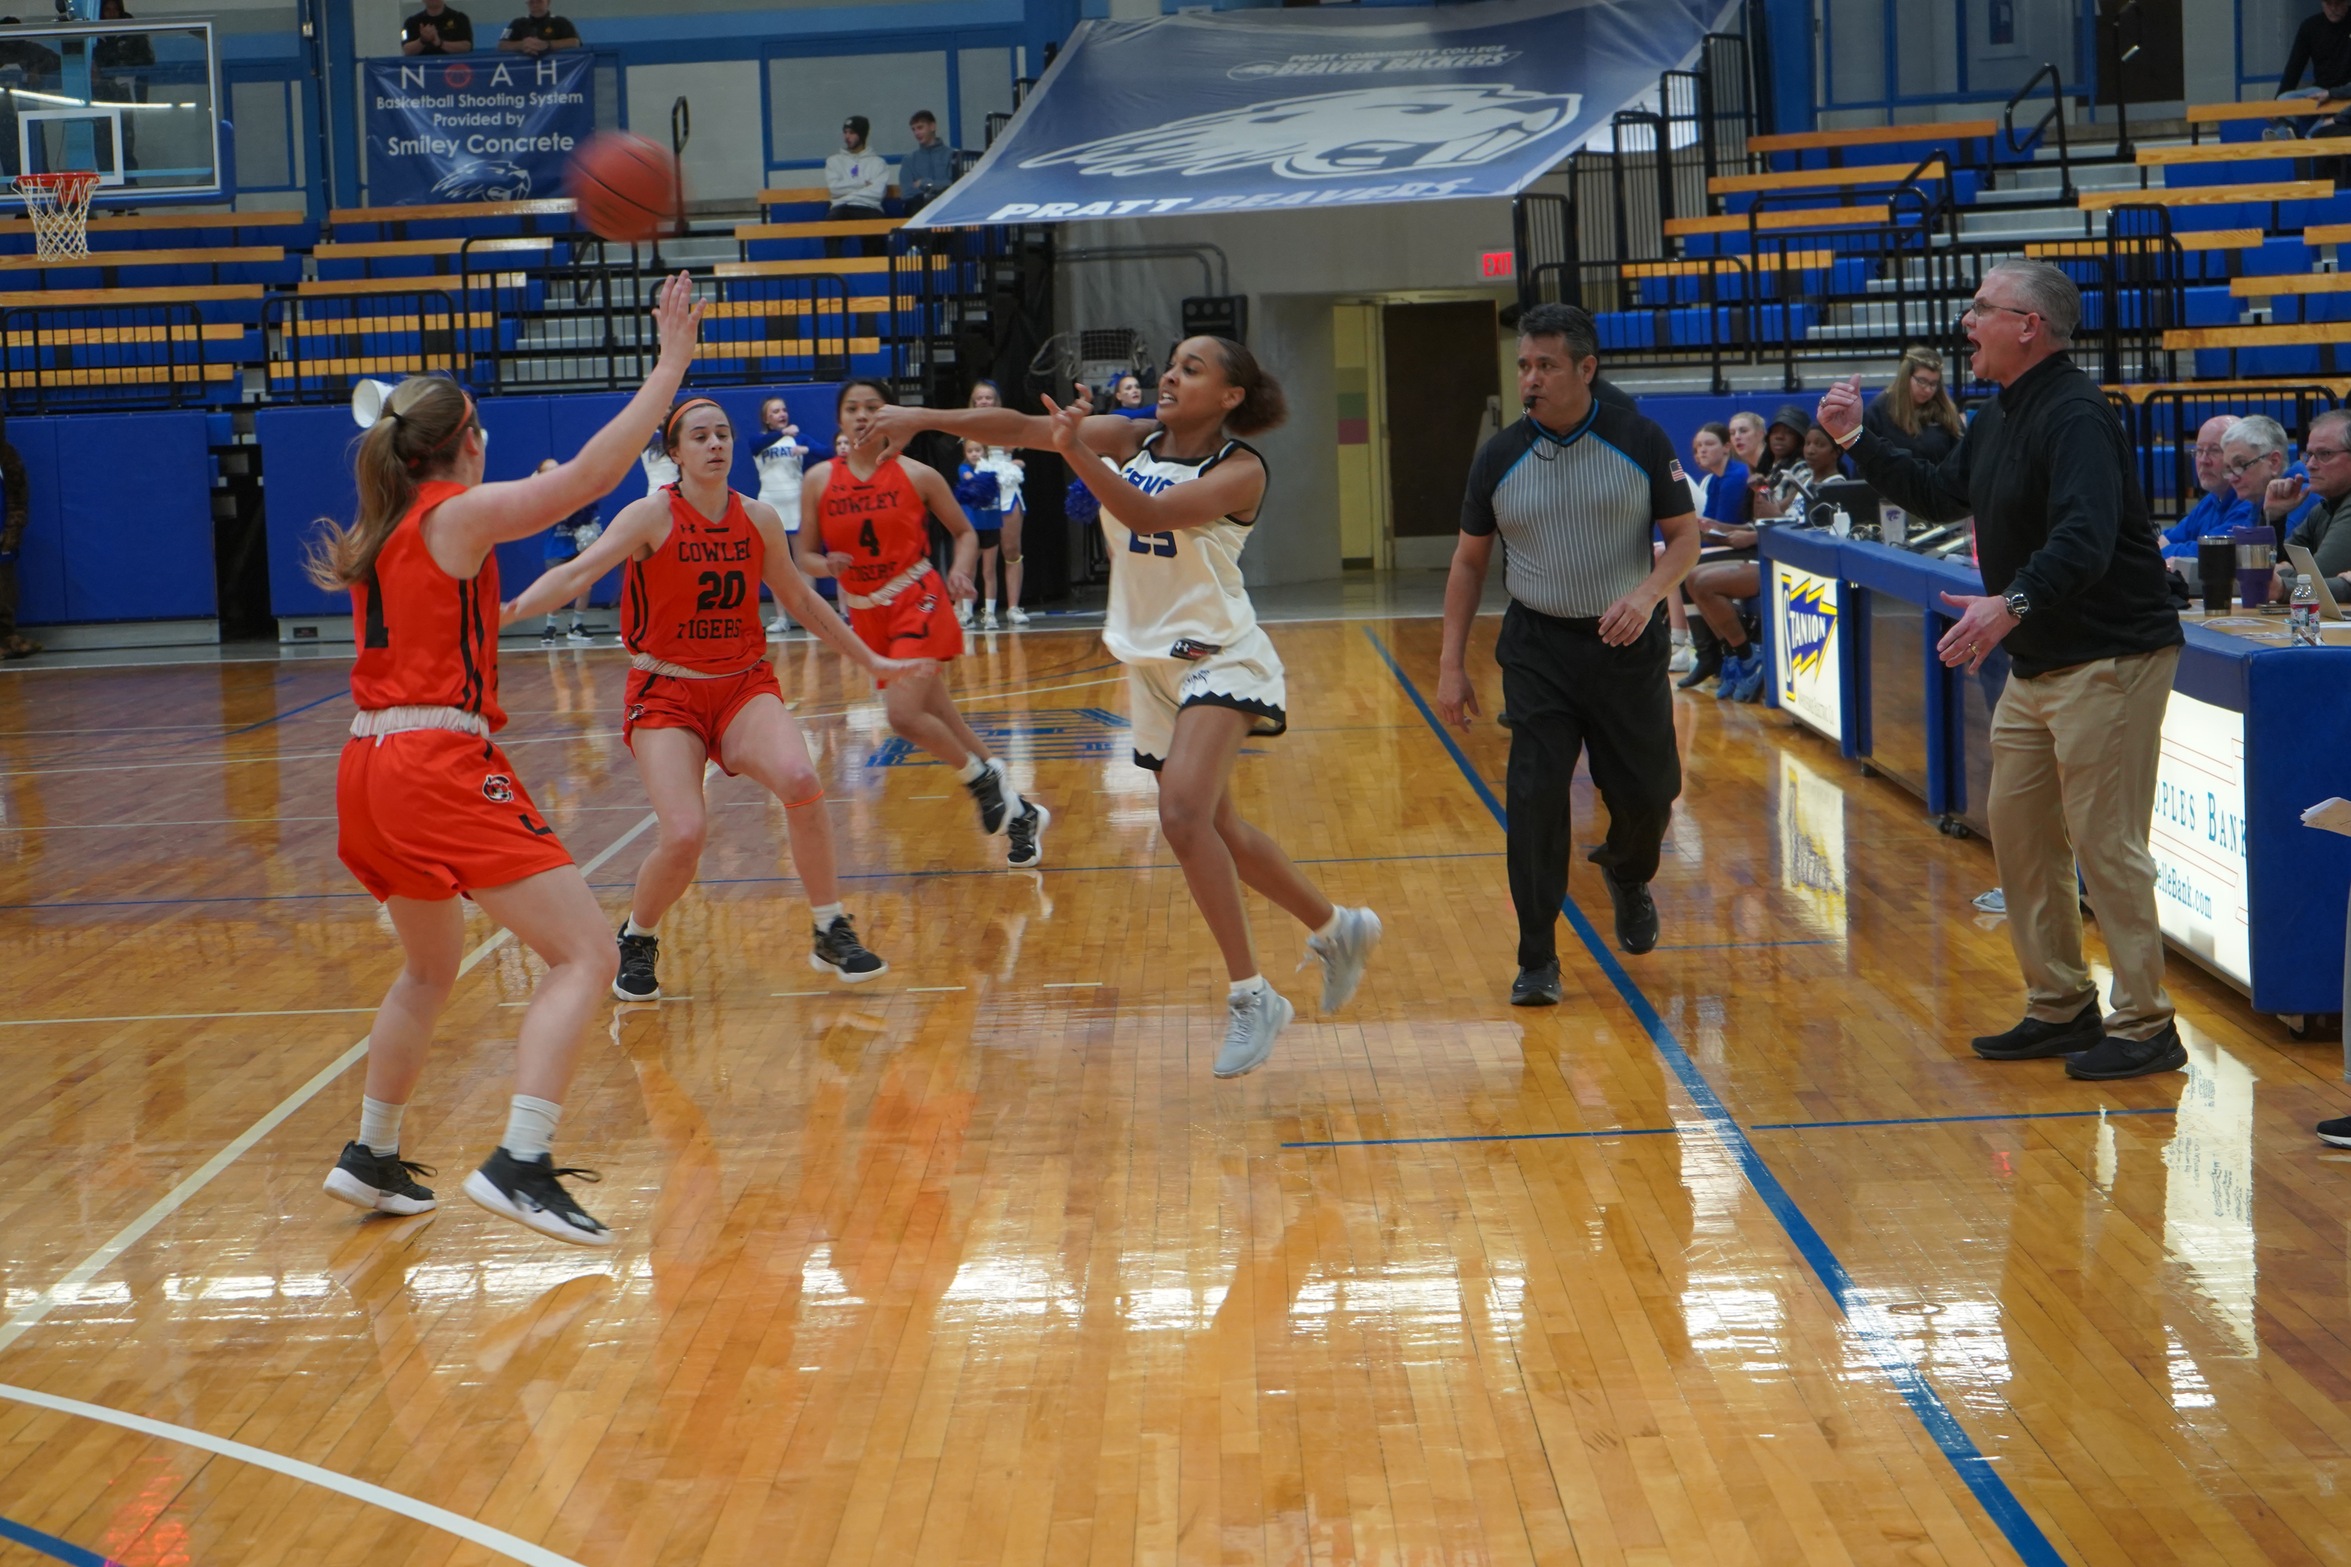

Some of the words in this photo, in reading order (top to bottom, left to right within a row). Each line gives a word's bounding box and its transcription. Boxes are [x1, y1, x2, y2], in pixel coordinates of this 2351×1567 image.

[1275, 58, 1379, 75] BEAVER
[1382, 51, 1508, 70] BACKERS
[1440, 44, 1507, 56] COLLEGE
[376, 95, 455, 110] Basketball
[458, 93, 525, 109] Shooting
[529, 91, 584, 107] System
[433, 112, 501, 127] Provided
[505, 112, 526, 128] by
[388, 135, 460, 158] Smiley
[467, 132, 575, 154] Concrete
[986, 197, 1194, 222] PRATT
[1197, 177, 1474, 210] BEAVERS
[1482, 251, 1513, 277] EXIT
[762, 445, 803, 465] PRAT
[858, 518, 881, 557] 4
[696, 570, 746, 613] 20
[1783, 589, 1827, 684] STANION
[2154, 859, 2213, 921] elleBank.com
